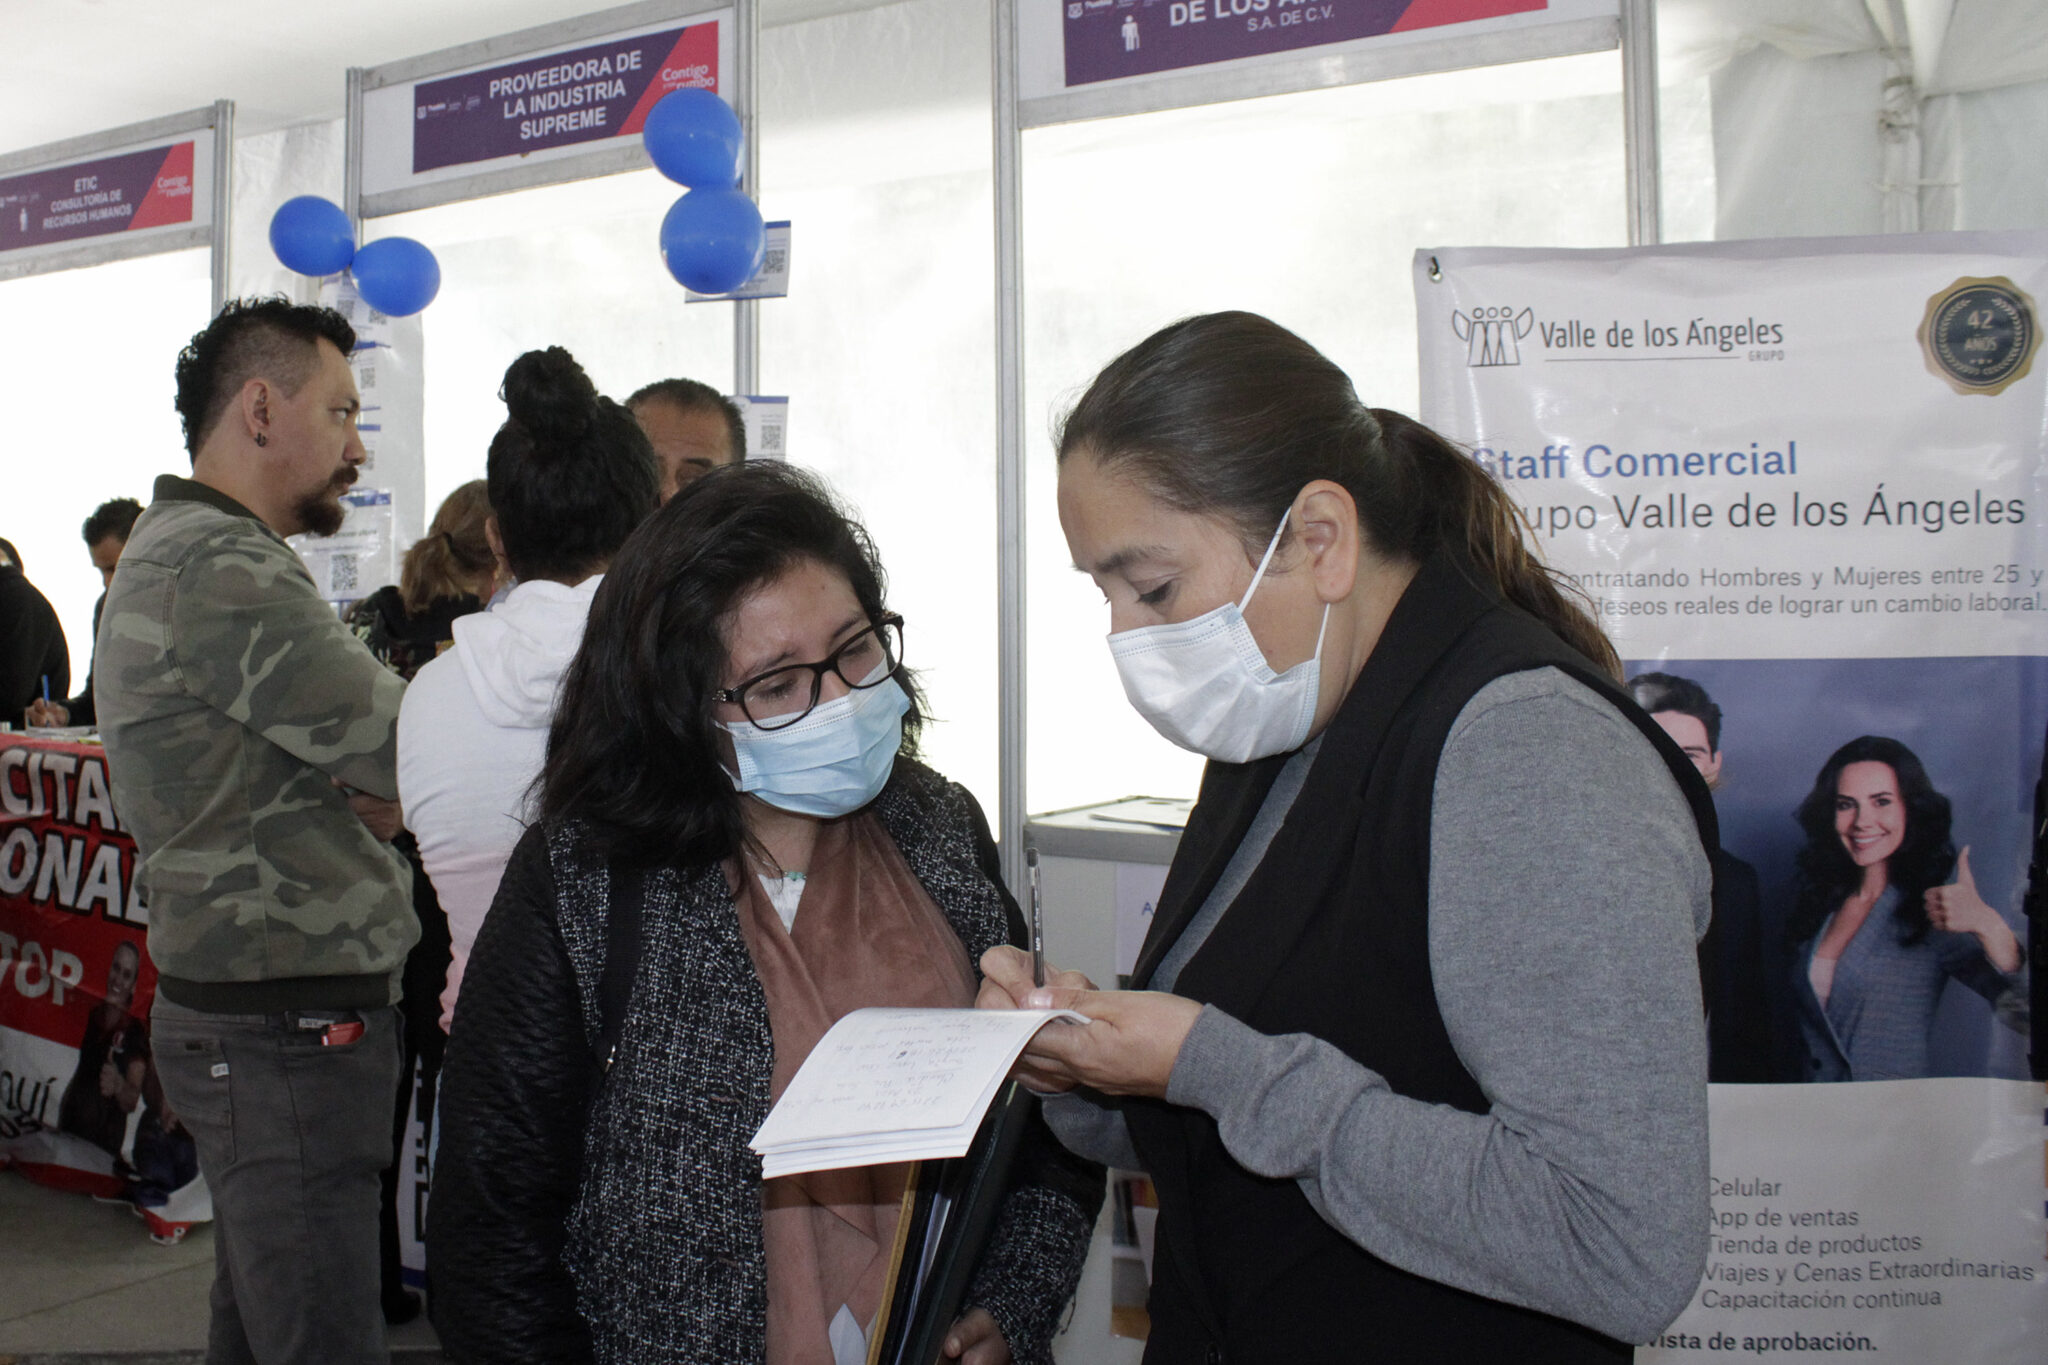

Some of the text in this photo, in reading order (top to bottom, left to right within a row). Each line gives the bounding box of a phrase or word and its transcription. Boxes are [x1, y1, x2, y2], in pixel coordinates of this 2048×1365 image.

[1169, 1, 1206, 27] DE
[1247, 5, 1335, 32] S.A. DE C.V.
[489, 49, 642, 99] PROVEEDORA DE
[662, 64, 709, 81] Contigo
[503, 99, 526, 119] LA
[530, 78, 626, 114] INDUSTRIA
[520, 106, 606, 140] SUPREME
[74, 175, 98, 193] ETIC
[51, 191, 108, 213] CONSULTORÍA
[109, 188, 122, 201] DE
[42, 203, 133, 230] RECURSOS HUMANOS
[1967, 309, 1994, 329] 42
[1540, 315, 1784, 353] Valle de los Ángeles
[1748, 350, 1785, 362] GRUPO
[1472, 441, 1798, 480] Staff Comercial
[1523, 483, 2026, 538] upo Valle de los Ángeles
[1701, 566, 1801, 588] Hombres
[1811, 571, 1824, 590] y
[1833, 566, 1921, 590] Mujeres
[1931, 567, 1985, 584] entre
[1992, 564, 2020, 584] 25
[2030, 568, 2045, 588] y
[1675, 595, 1739, 616] reales
[1745, 594, 1773, 614] de
[1779, 594, 1844, 618] lograr
[1851, 602, 1878, 614] un
[1884, 593, 1962, 613] cambio
[1968, 591, 2047, 612] laboral.
[0, 748, 119, 831] CITA
[1709, 1177, 1782, 1198] Celular
[1709, 1207, 1859, 1229] App de ventas
[1709, 1232, 1922, 1258] Tienda de productos
[1703, 1256, 2035, 1287] Viajes y Cenas Extraordinarias
[1701, 1287, 1942, 1312] Capacitación continua
[1708, 1331, 1737, 1351] de
[1742, 1330, 1877, 1355] aprobación.
